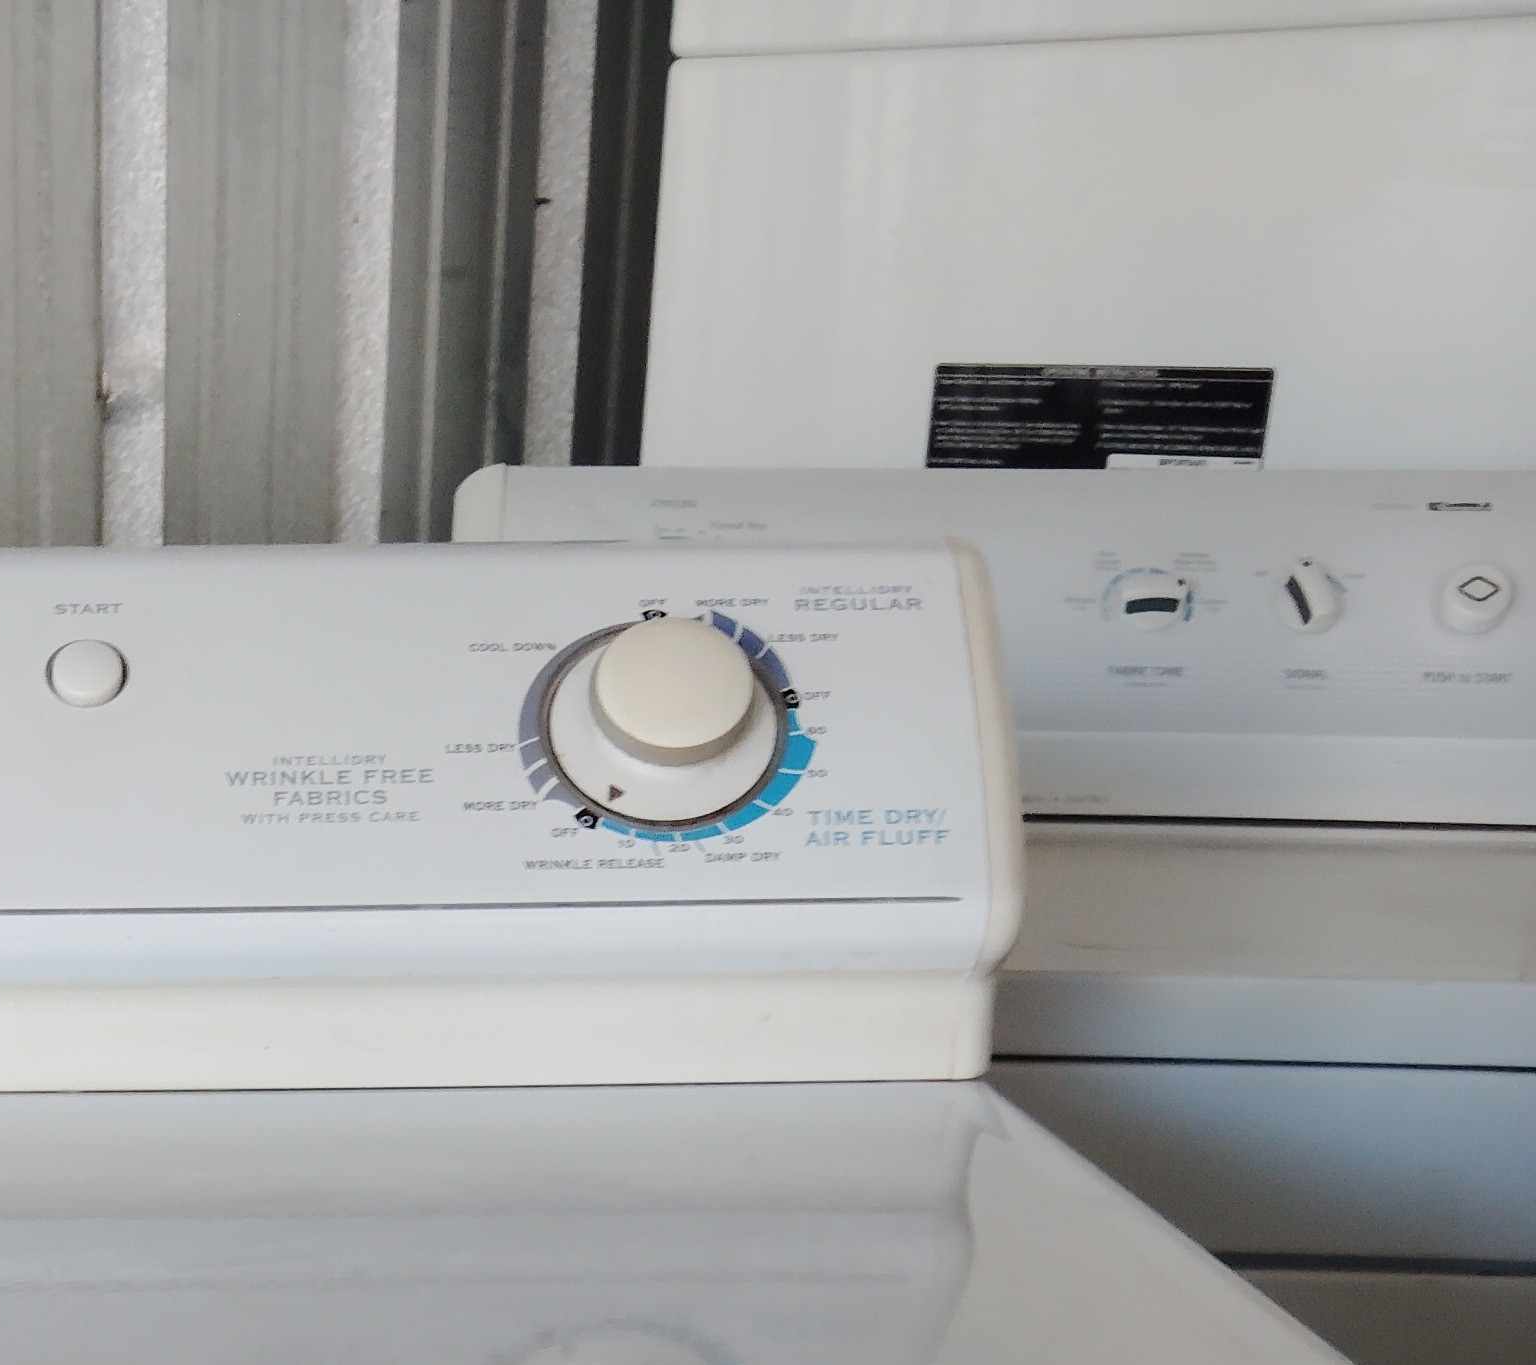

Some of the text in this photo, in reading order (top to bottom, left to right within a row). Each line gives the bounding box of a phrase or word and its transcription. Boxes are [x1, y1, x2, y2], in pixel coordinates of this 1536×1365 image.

[54, 602, 124, 615] START
[639, 599, 668, 607] OFF
[695, 598, 770, 607] MORE DRY
[794, 598, 924, 611] REGULAR
[767, 633, 806, 643] LESS
[468, 642, 558, 652] COOL DOWN
[445, 742, 517, 754] LESS DRY
[272, 754, 388, 767] INTELLIDRY
[224, 768, 436, 787] WRINKLE FREE
[272, 789, 389, 807] FABRICS
[462, 800, 539, 811] MORE DRY
[240, 810, 421, 825] WITH PRESS CARE
[807, 809, 875, 826] TIME
[550, 828, 580, 838] OFF
[804, 829, 952, 847] AIR FLUFF
[617, 839, 636, 849] 10
[722, 835, 745, 845] 30
[668, 843, 691, 853] 20
[704, 851, 782, 863] DAMP DRY
[523, 857, 666, 870] WRINKLE RELEASE
